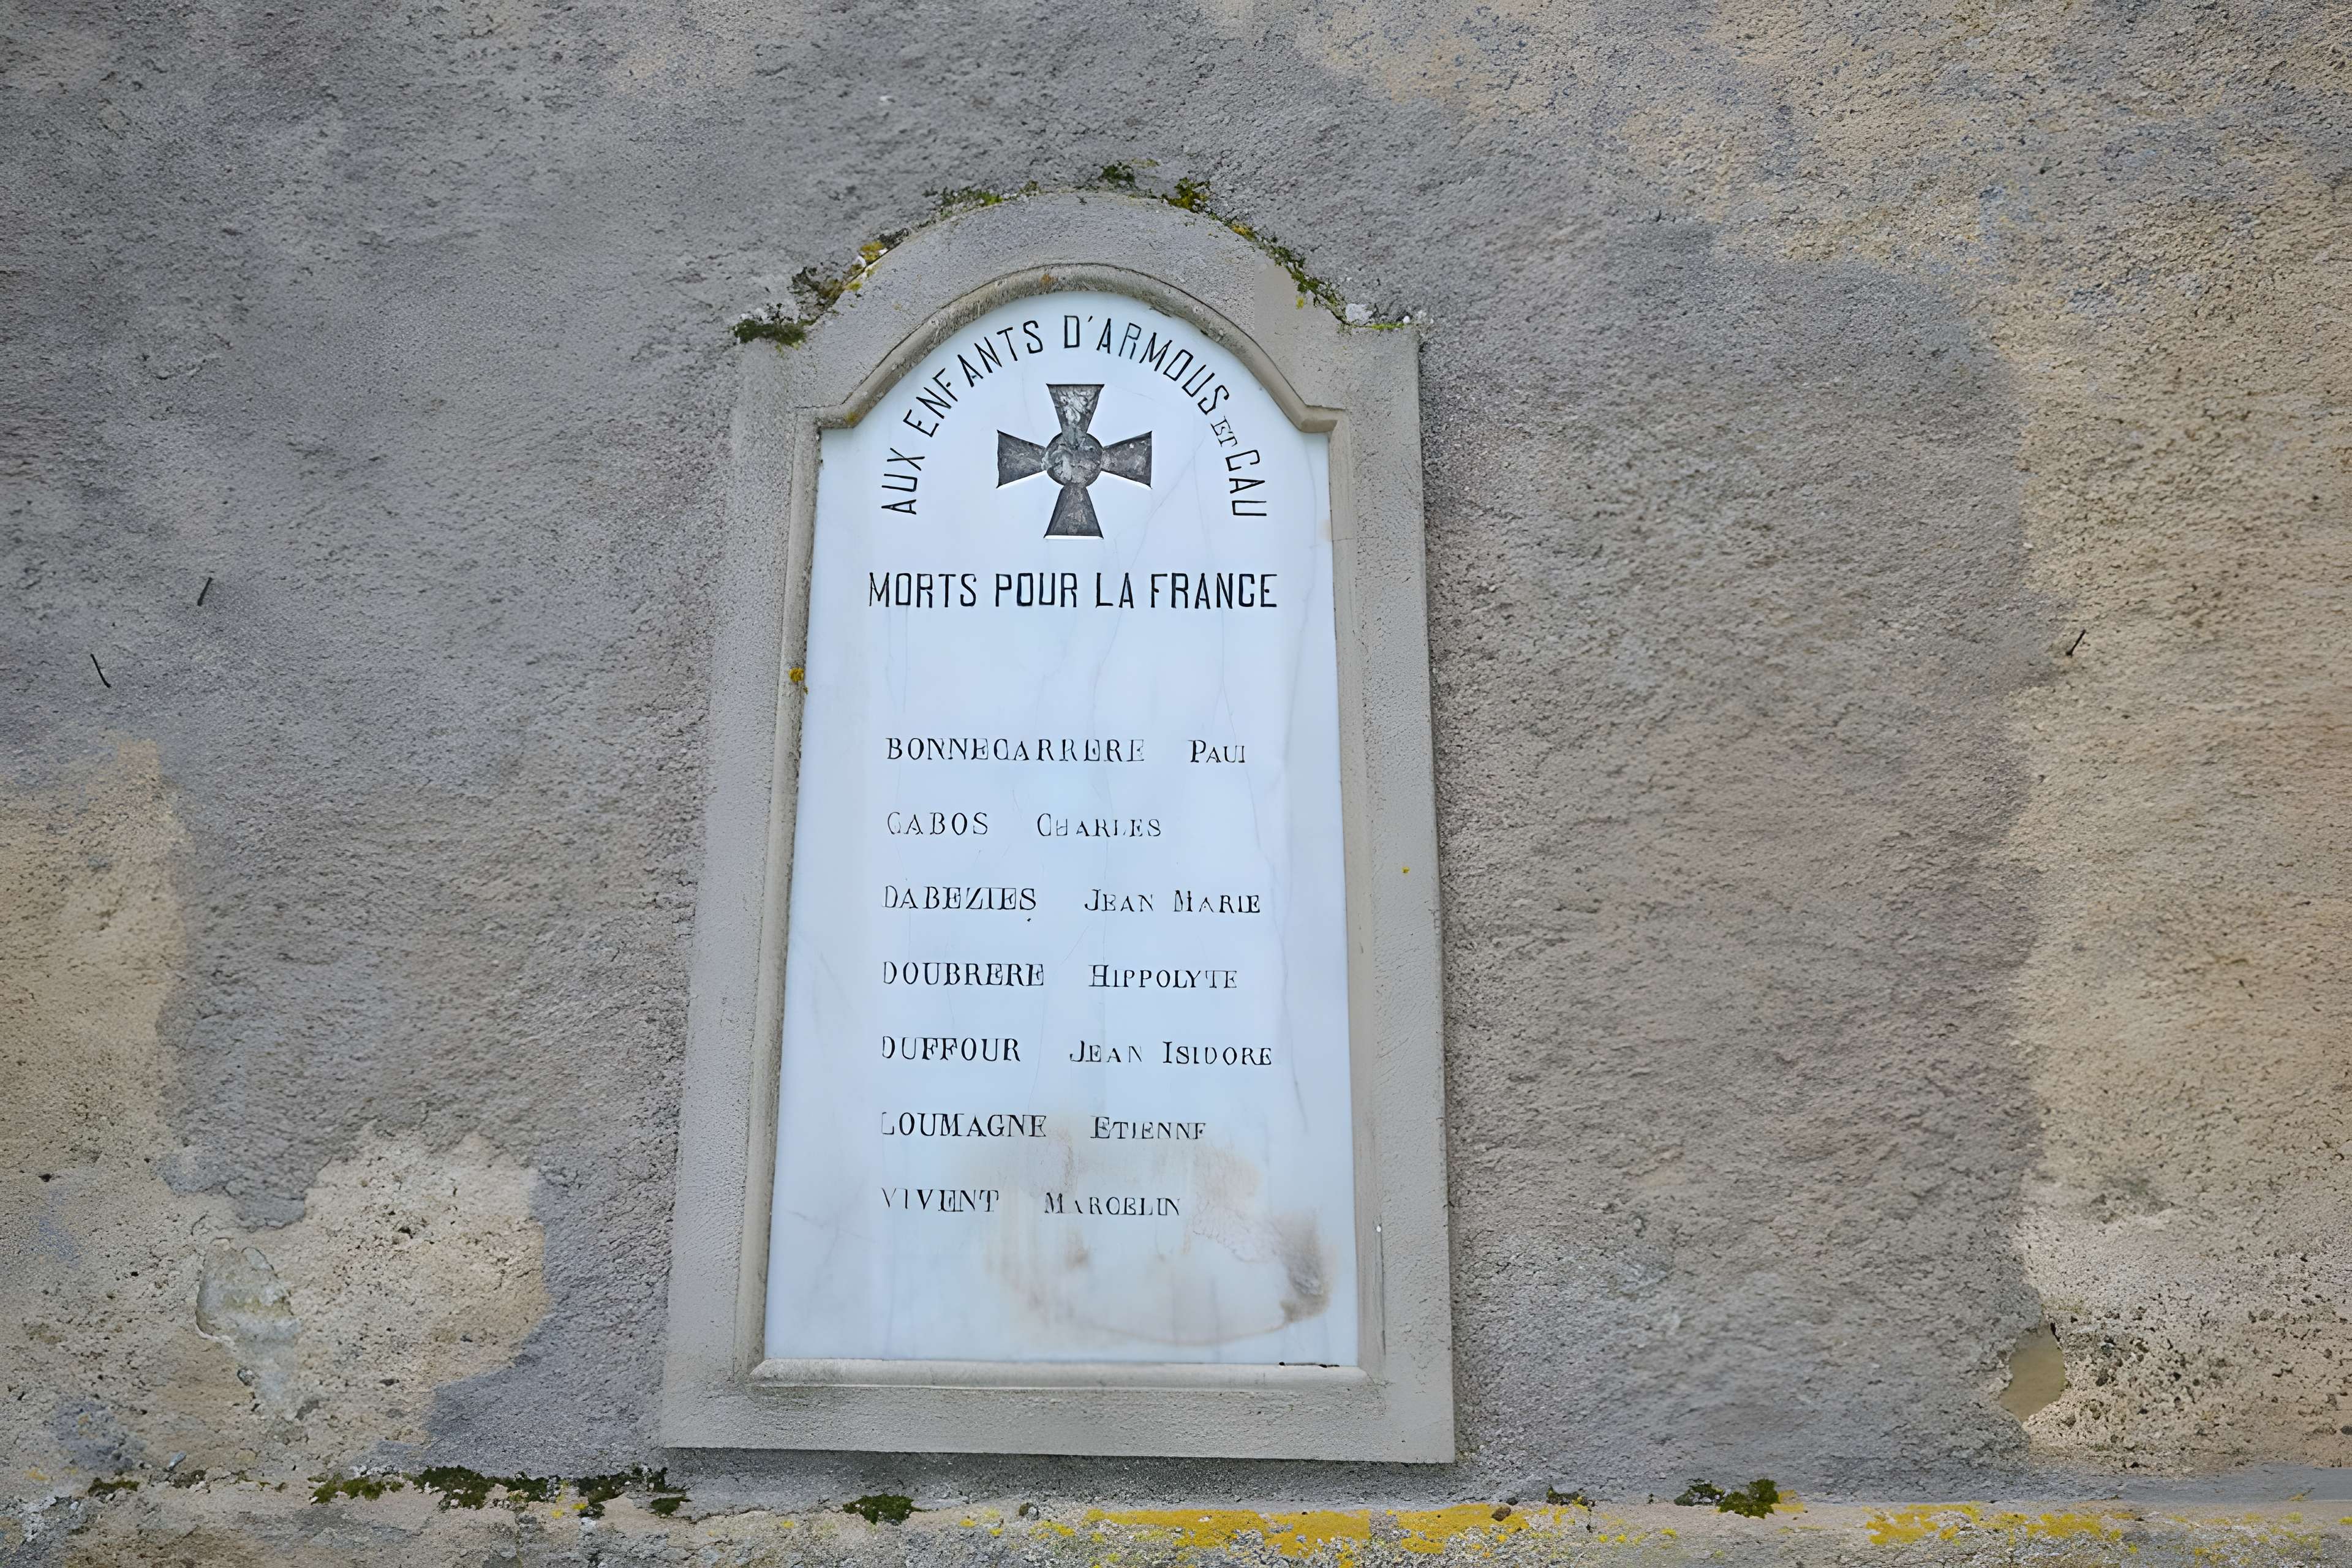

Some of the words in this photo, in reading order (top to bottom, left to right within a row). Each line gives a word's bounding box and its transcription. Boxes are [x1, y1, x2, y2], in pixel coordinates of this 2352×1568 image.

[881, 448, 925, 514] AUX
[903, 320, 1043, 438] ENFANTS
[1063, 315, 1229, 415] D'ARMOUS
[1210, 416, 1237, 447] ET
[1225, 450, 1267, 516] CAU
[869, 572, 976, 609] MORTS
[995, 573, 1077, 608] POUR
[1096, 572, 1134, 609] LA
[1151, 573, 1277, 609] FRANCE
[883, 886, 1036, 910] DABEZIES
[1084, 889, 1153, 912] JEAN
[1174, 890, 1260, 913] MARIE
[883, 962, 1044, 986] DOUBRERE
[1088, 965, 1237, 989] HIPPOLYTE
[882, 1036, 1020, 1061] DUFFOUR
[1069, 1041, 1142, 1063] JEAN
[1163, 1041, 1272, 1065] ISIDORE
[882, 1112, 1046, 1137] LOUMAGNE
[882, 1188, 998, 1212] VIVENT
